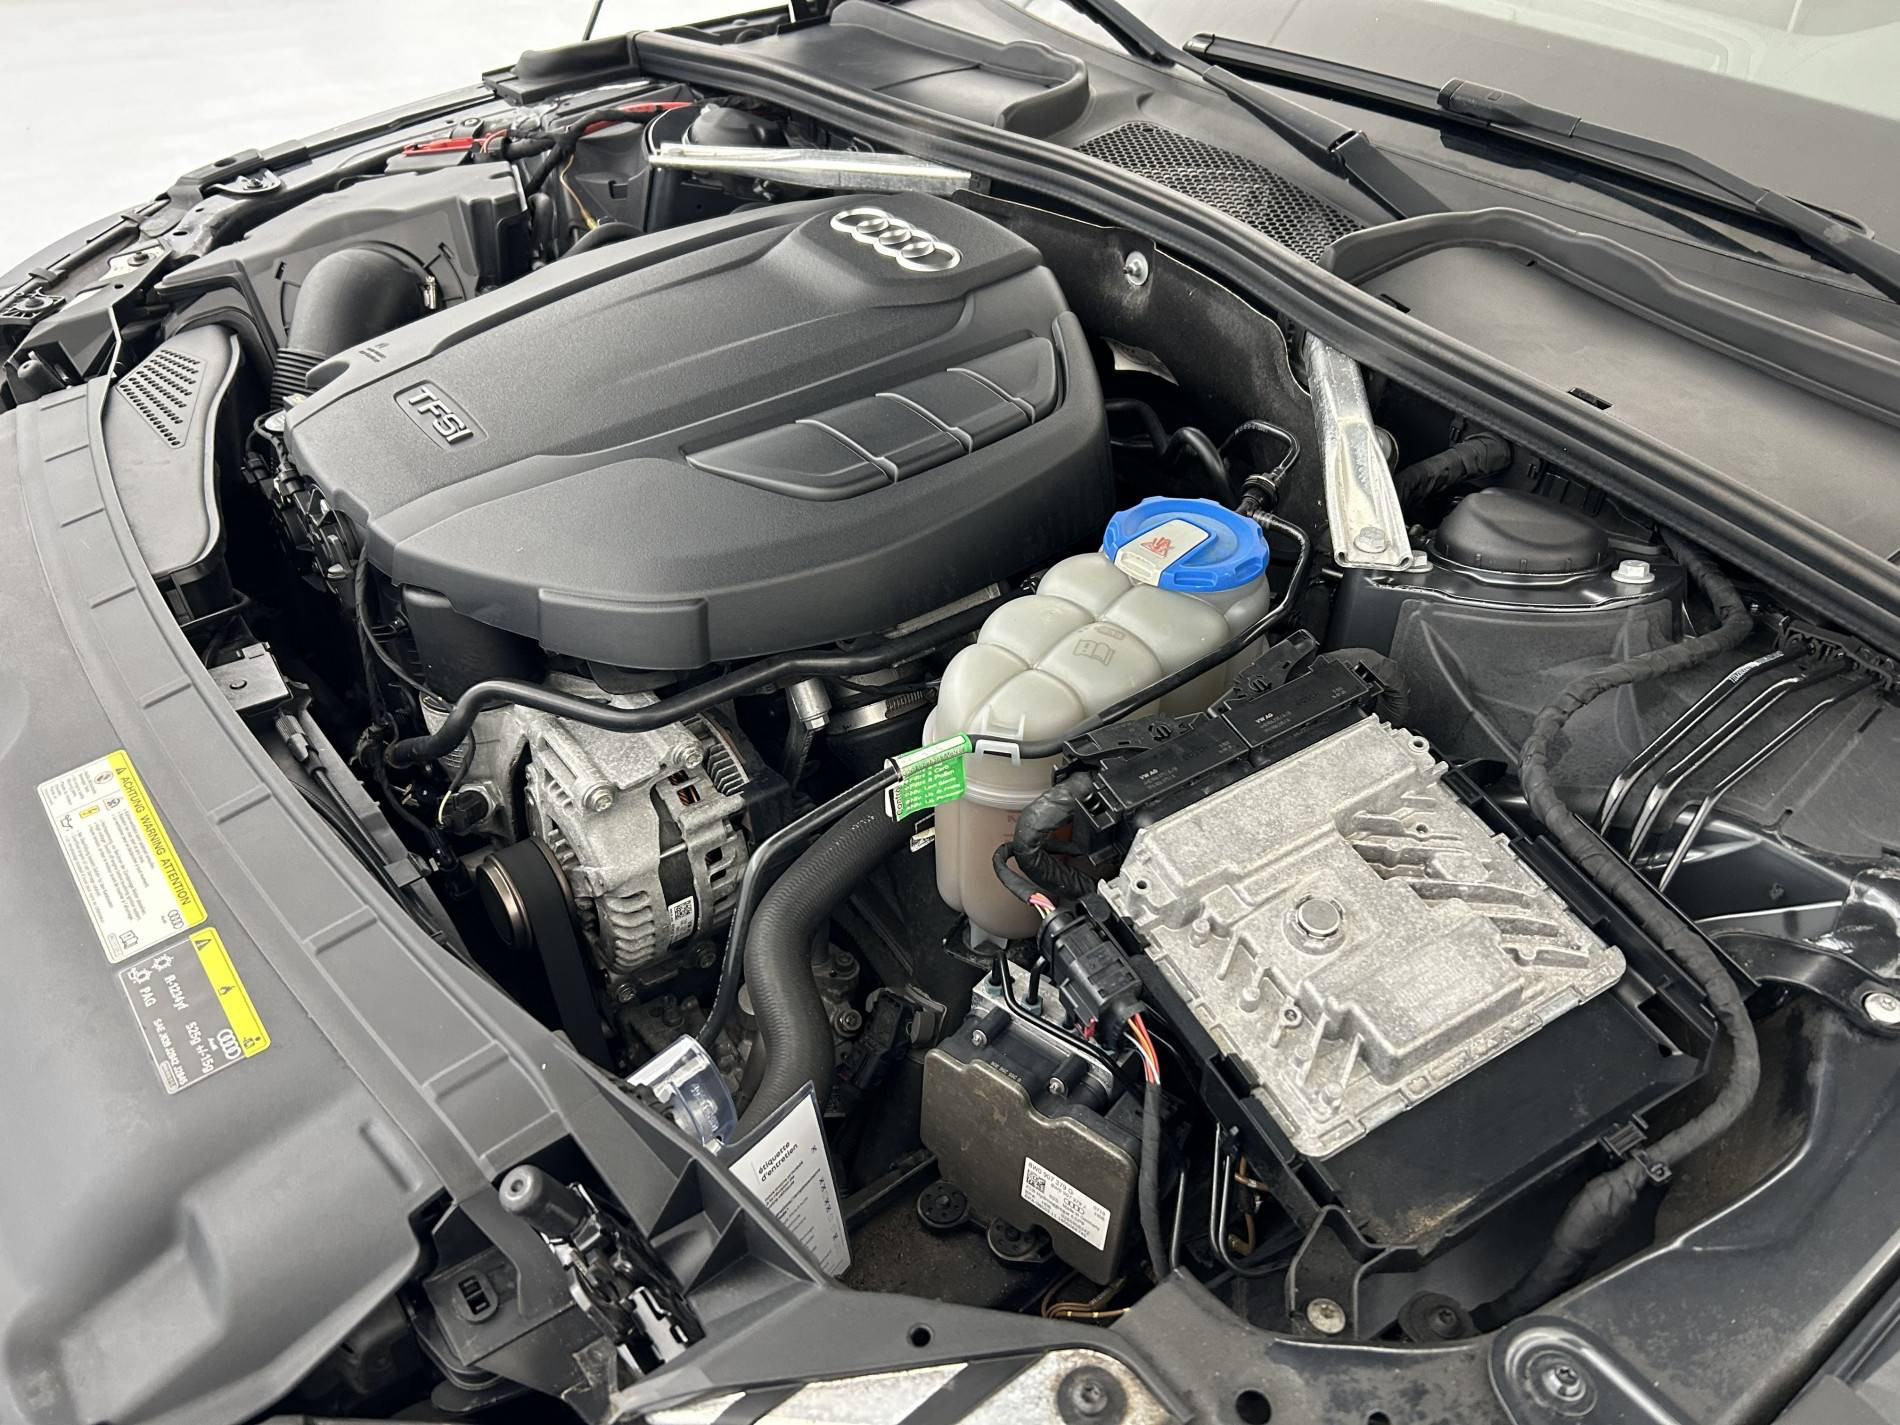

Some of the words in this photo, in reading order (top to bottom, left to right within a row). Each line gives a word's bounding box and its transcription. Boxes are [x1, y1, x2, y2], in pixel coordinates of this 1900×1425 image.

[408, 386, 474, 445] TFSI
[121, 776, 146, 814] ACHTUNG
[140, 815, 166, 856] WARNING
[160, 858, 191, 906] ATTENTION
[139, 986, 157, 1008] PAG
[185, 1021, 202, 1046] 525g
[758, 1141, 790, 1175] étiquette
[761, 1143, 798, 1182] d'entretien
